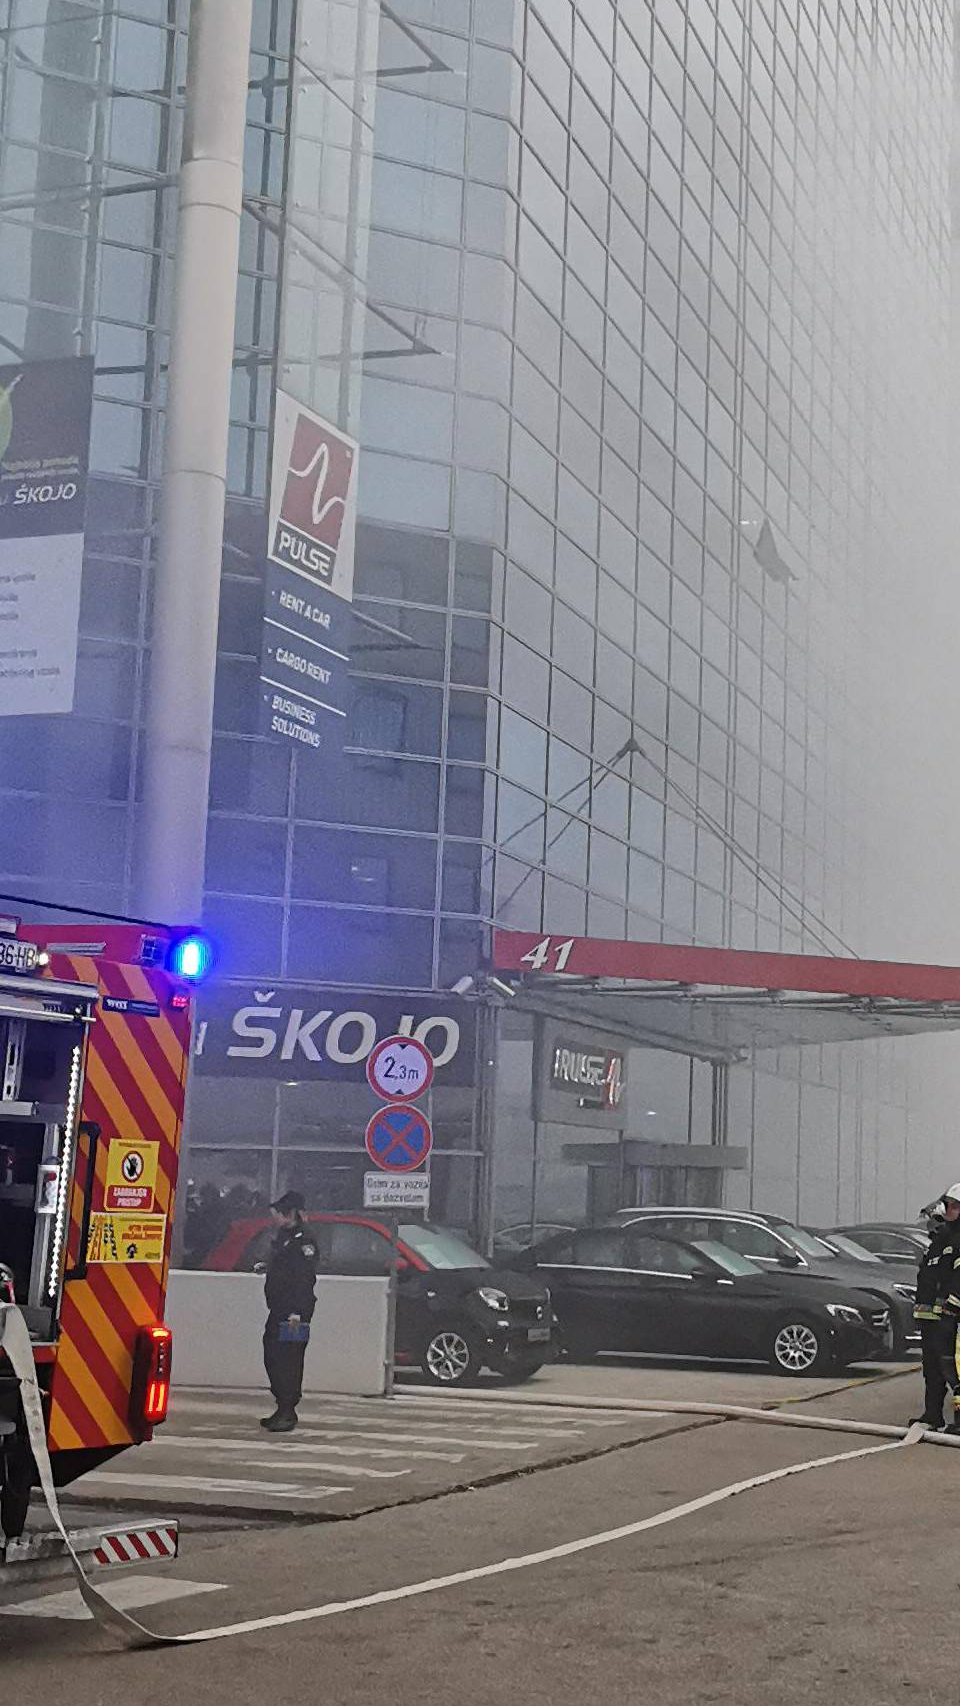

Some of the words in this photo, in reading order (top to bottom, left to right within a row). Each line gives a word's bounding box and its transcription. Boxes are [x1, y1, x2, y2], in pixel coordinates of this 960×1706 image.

[13, 483, 77, 505] ŠKOJO
[278, 530, 332, 577] PULSE
[279, 590, 305, 614] RENT
[304, 604, 312, 620] A
[312, 608, 332, 630] CAR
[275, 647, 307, 673] CARGO
[307, 662, 332, 685] RENT
[271, 695, 317, 726] BUSINESS
[270, 715, 321, 749] SOLUTIONS
[520, 936, 575, 971] 41
